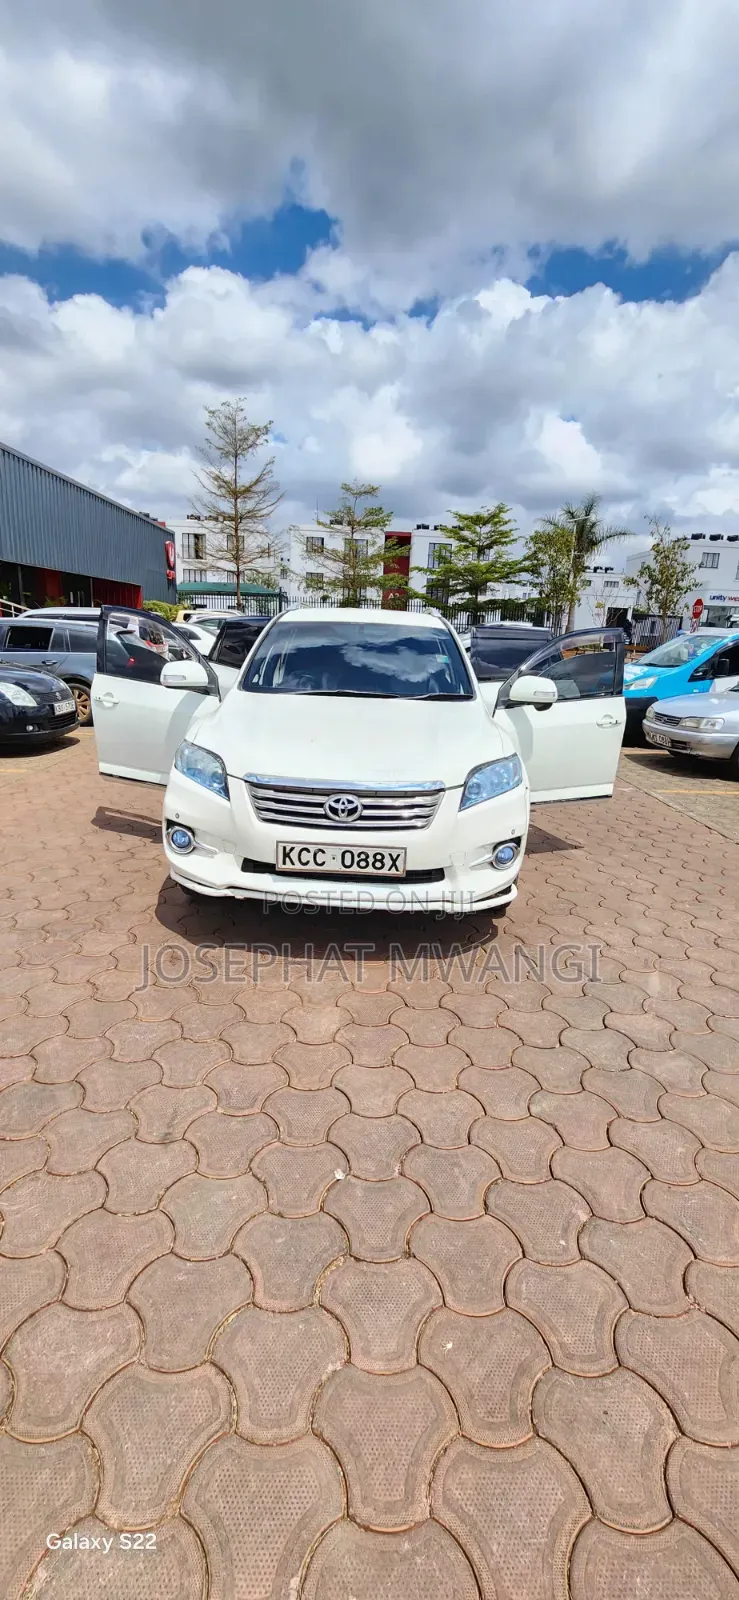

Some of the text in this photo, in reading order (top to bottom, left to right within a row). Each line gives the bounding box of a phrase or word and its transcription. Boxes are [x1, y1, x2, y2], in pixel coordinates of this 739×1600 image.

[709, 594, 727, 602] unity
[281, 845, 402, 873] KCC 088X
